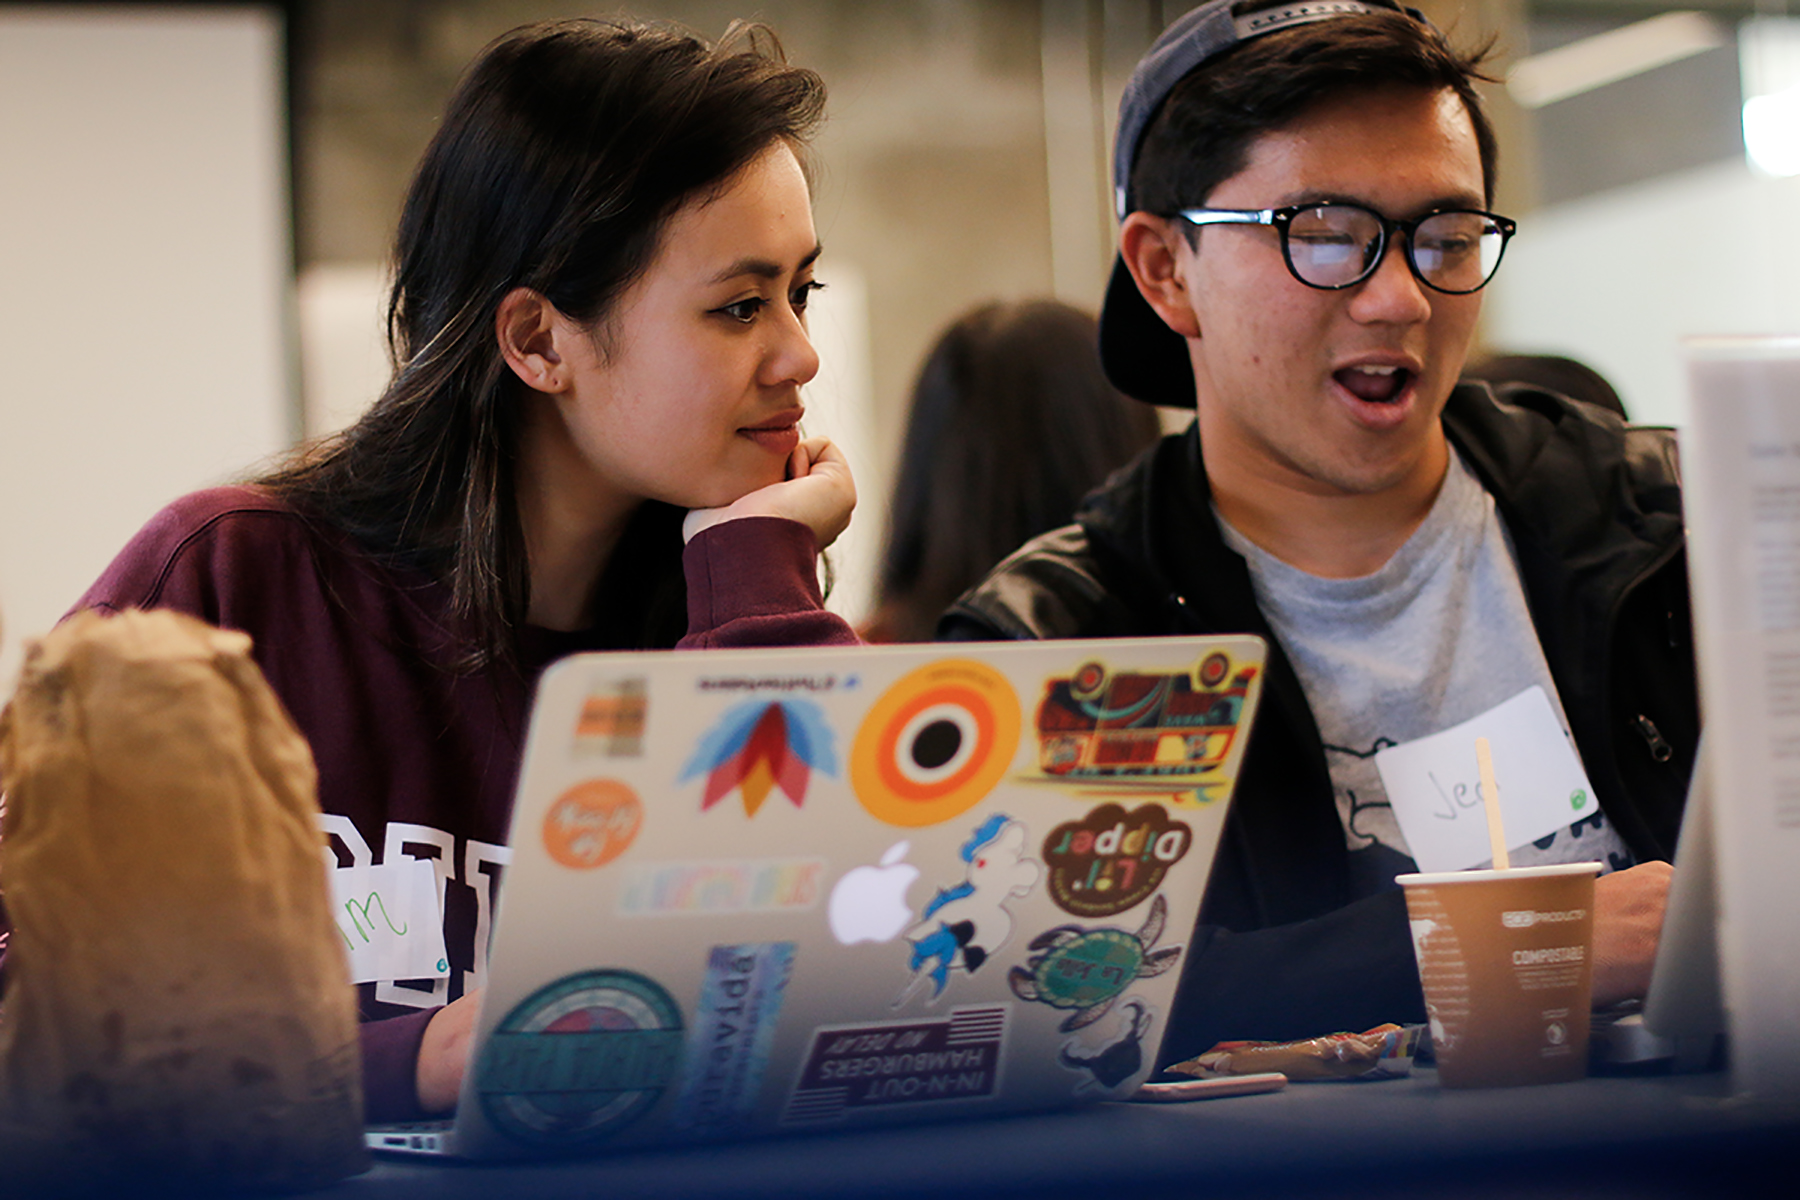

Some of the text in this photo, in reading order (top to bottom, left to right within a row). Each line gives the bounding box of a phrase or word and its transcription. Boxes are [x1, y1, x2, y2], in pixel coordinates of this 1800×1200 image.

[1052, 822, 1184, 863] Dipper
[1512, 945, 1584, 965] COMPOSTABLE
[819, 1048, 985, 1079] HAMBURGERS
[864, 1071, 985, 1100] IN-N-OUT
